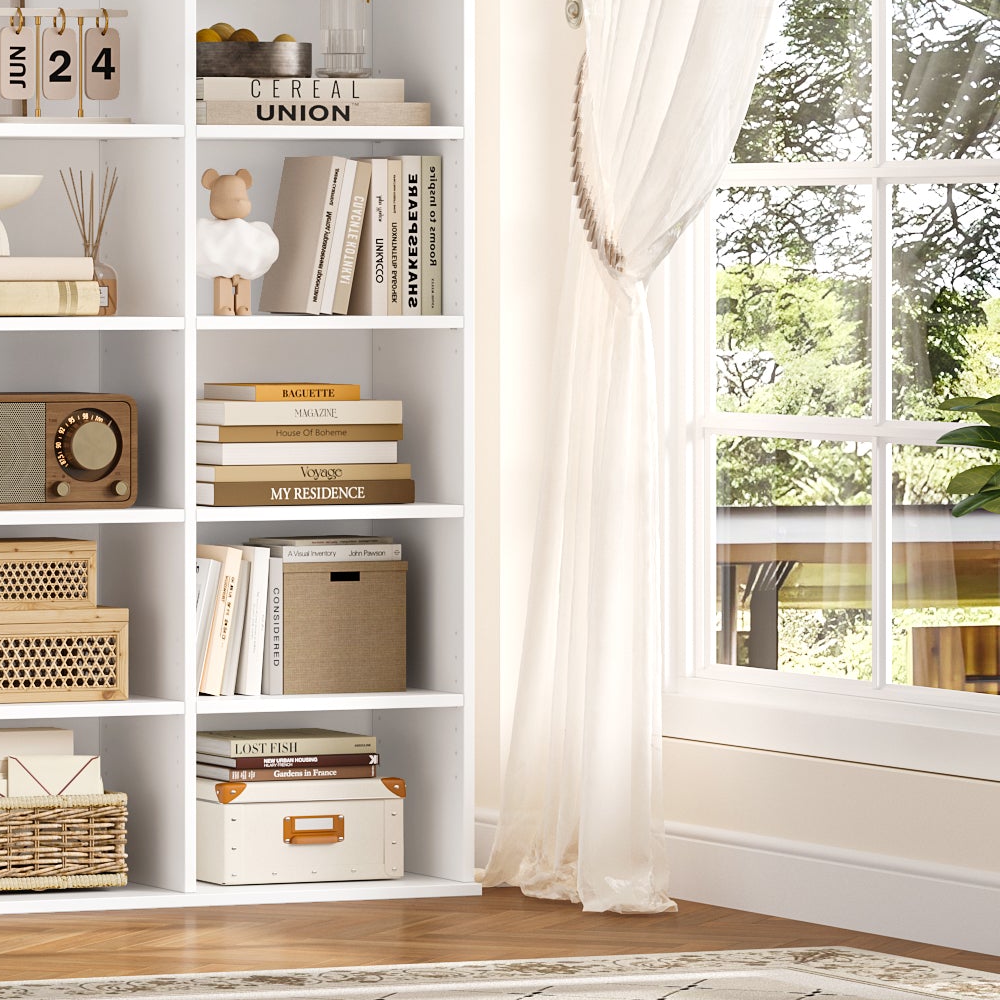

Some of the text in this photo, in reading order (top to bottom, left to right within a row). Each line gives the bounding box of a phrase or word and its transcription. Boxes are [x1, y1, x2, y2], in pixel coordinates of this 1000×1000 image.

[9, 46, 27, 89] JUN
[250, 78, 360, 99] CEREAL
[256, 104, 351, 121] UNION
[282, 389, 336, 398] BAGUETTE
[81, 412, 89, 420] 98
[294, 408, 338, 418] MAGAZINE
[67, 415, 76, 424] 95
[58, 426, 66, 435] 92
[276, 428, 348, 437] House Of Boheme
[55, 441, 62, 449] 90
[300, 466, 343, 480] Voyage
[270, 486, 366, 500] MY RESIDENCE
[311, 550, 337, 558] Inventory
[363, 549, 386, 557] Pawson
[235, 742, 298, 755] LOST FISH
[273, 768, 337, 778] Gardens in France
